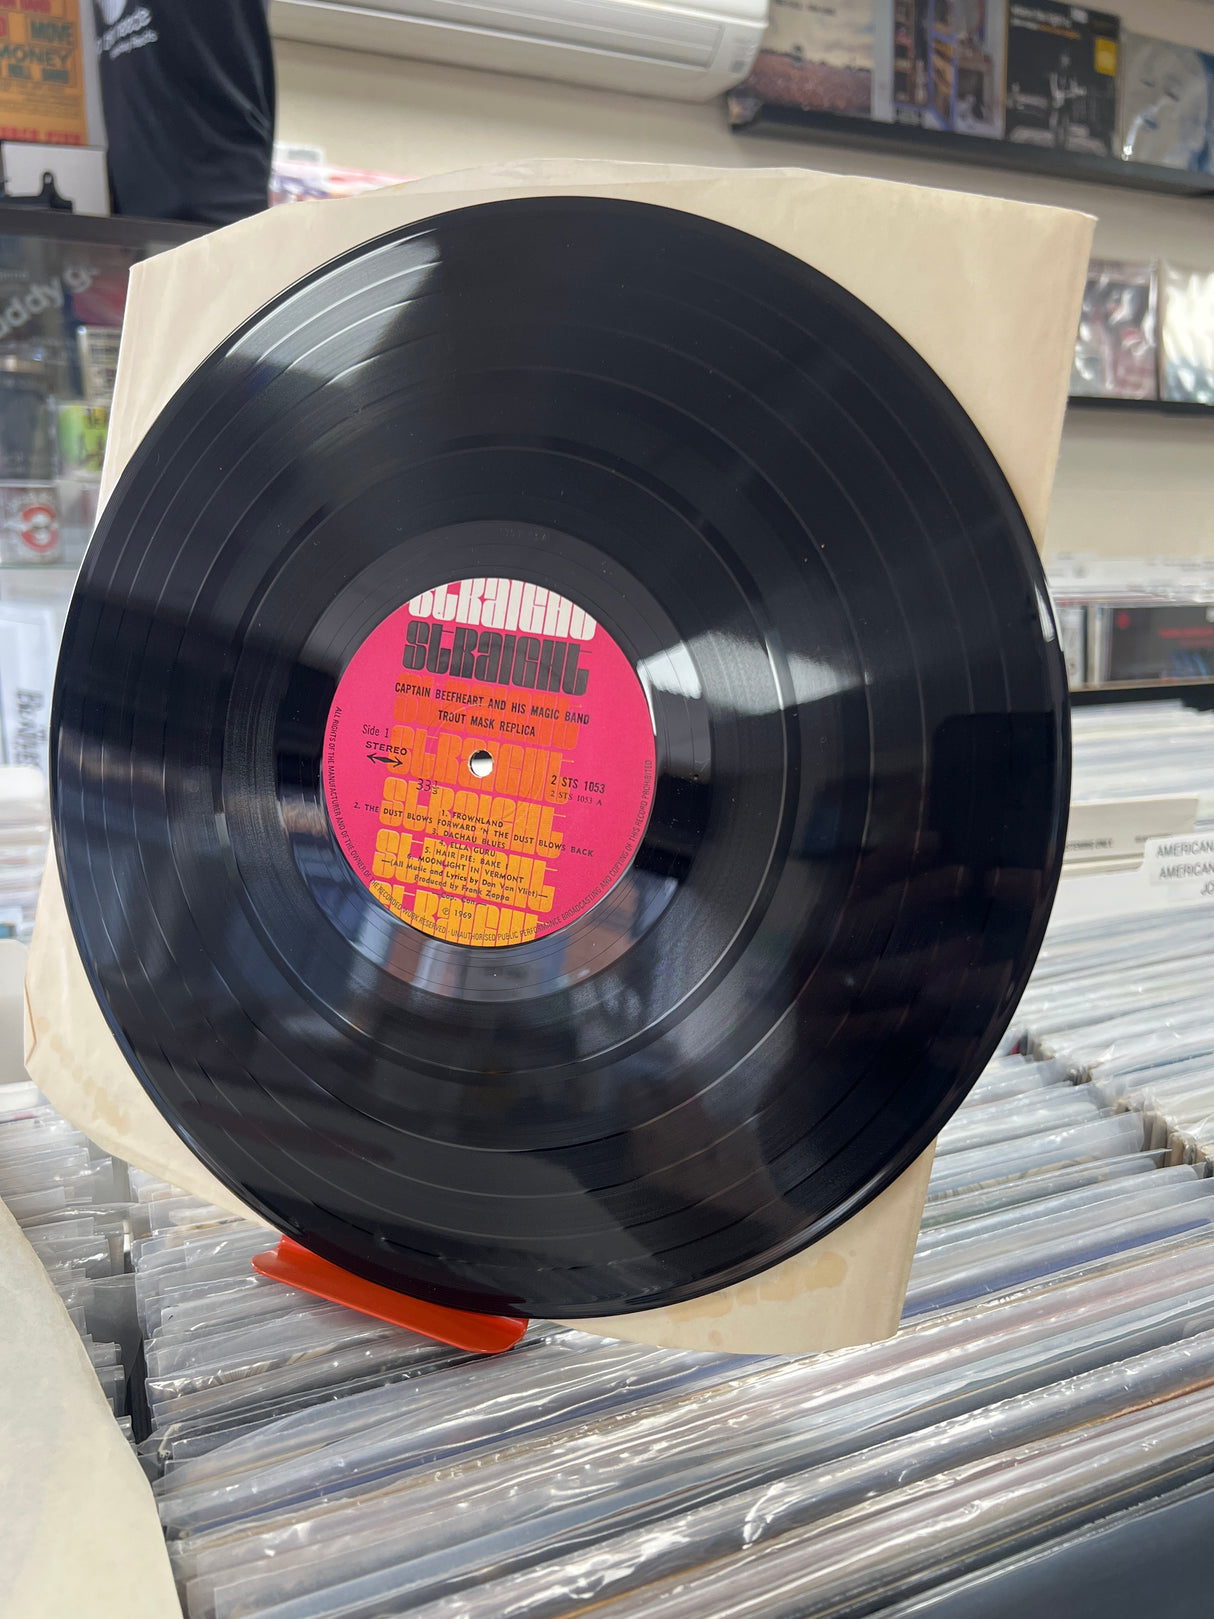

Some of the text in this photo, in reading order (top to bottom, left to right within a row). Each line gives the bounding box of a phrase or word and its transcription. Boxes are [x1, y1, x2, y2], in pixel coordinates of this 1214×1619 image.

[395, 682, 590, 725] CAPTAIN BEEFHEART AND HIS MAGIC BAND
[334, 706, 342, 718] ALL
[329, 719, 339, 742] RIGHTS
[362, 724, 389, 738] Side 1
[438, 710, 536, 737] TROUT MASK REPLICA
[328, 743, 336, 751] OF
[365, 741, 408, 756] STEREO
[551, 774, 606, 794] 2 STS 1053
[642, 760, 652, 800] PROHIBITED
[328, 766, 341, 818] MANUFACTURER
[559, 792, 573, 801] STS
[577, 795, 593, 804] 1053
[452, 812, 503, 828] FROWNLAND
[634, 801, 648, 826] RECORD
[336, 817, 346, 831] AND
[364, 804, 379, 813] THE
[383, 808, 403, 818] DUST
[407, 812, 433, 824] BLOWS
[437, 819, 476, 832] FORWARD
[494, 830, 509, 840] THE
[513, 834, 535, 845] DUST
[538, 839, 566, 852] BLOWS
[571, 846, 594, 857] BACK
[341, 830, 349, 839] OF
[432, 828, 506, 849] 3. DACHAU BLUES
[628, 826, 640, 842] THIS
[344, 838, 354, 851] THE
[450, 841, 469, 851] ELLA
[473, 847, 496, 857] GURU
[625, 842, 633, 851] OF
[350, 849, 367, 872] OWNER
[424, 846, 432, 854] 5.
[435, 849, 456, 859] HAIR
[460, 854, 475, 863] PIE:
[480, 858, 502, 869] BAKE
[609, 852, 629, 877] COPYING
[363, 870, 372, 878] OF
[406, 863, 427, 873] Music
[429, 868, 443, 877] and
[446, 871, 467, 882] Lyrics
[469, 877, 479, 886] by
[482, 879, 496, 888] Don
[499, 883, 514, 892] Van
[417, 856, 467, 871] MOONLIGHT
[470, 866, 480, 874] IN
[484, 868, 525, 884] VERMONT
[369, 877, 379, 888] THE
[414, 874, 510, 901] Produced by Frank Zappa
[599, 874, 612, 889] AND
[377, 884, 402, 911] RECORDED
[561, 886, 602, 921] BROADCASTING
[402, 908, 419, 922] WORK
[454, 909, 473, 920] 1969
[419, 917, 446, 934] RESERVED
[451, 929, 496, 942] UNAUTHORISED
[497, 931, 519, 941] PUBLIC
